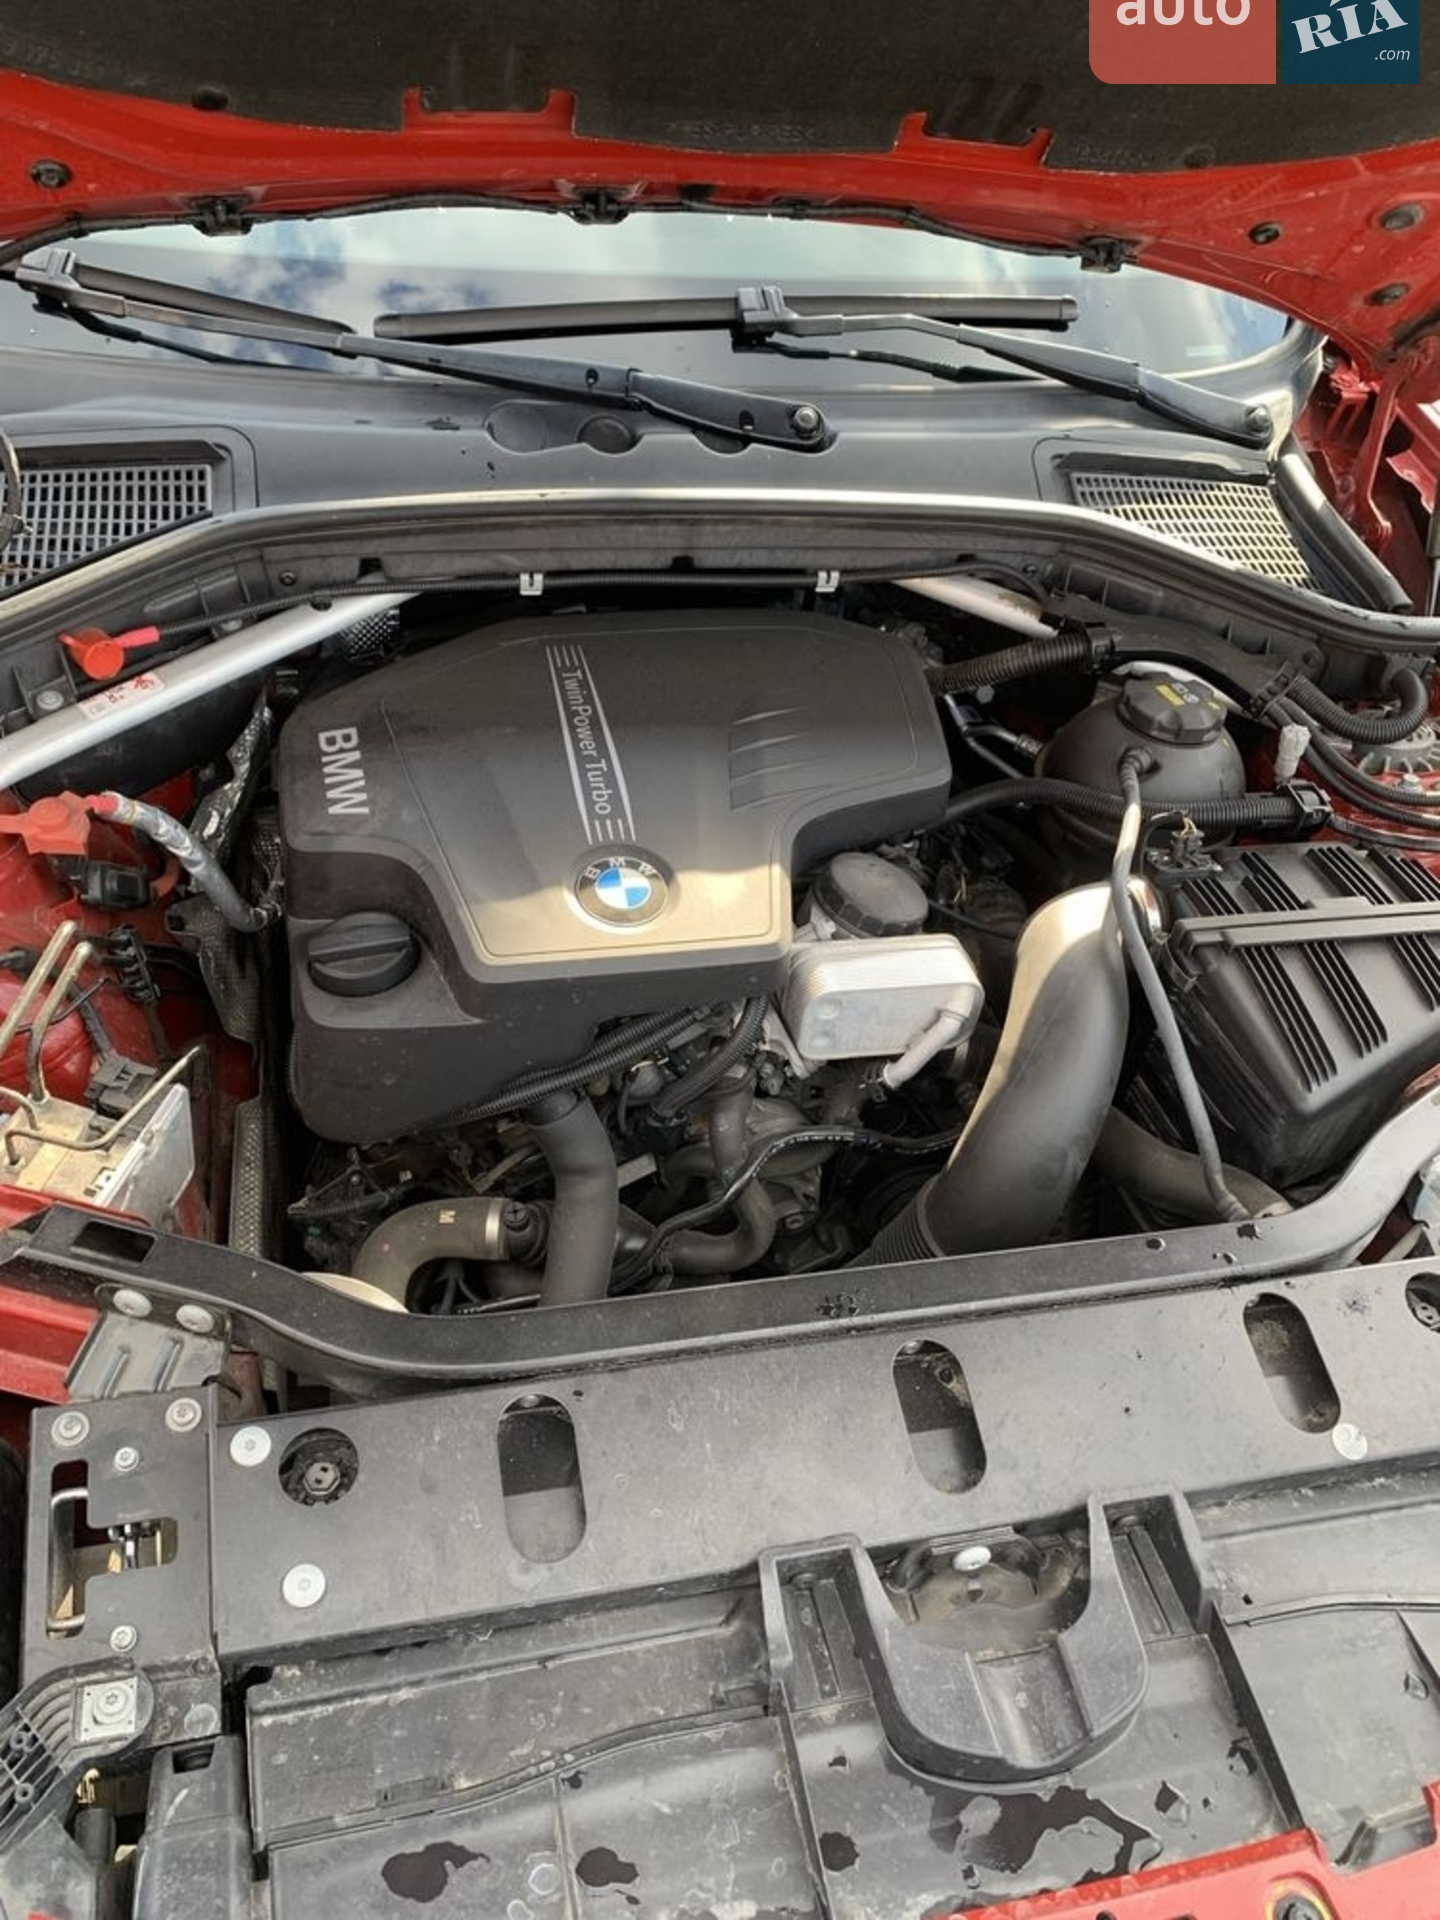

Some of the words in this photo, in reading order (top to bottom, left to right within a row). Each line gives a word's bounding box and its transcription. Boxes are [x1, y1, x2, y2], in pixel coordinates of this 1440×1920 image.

[318, 726, 370, 815] BMW
[562, 669, 598, 757] TwinPower
[585, 758, 614, 815] Turbo
[582, 857, 658, 880] BMW
